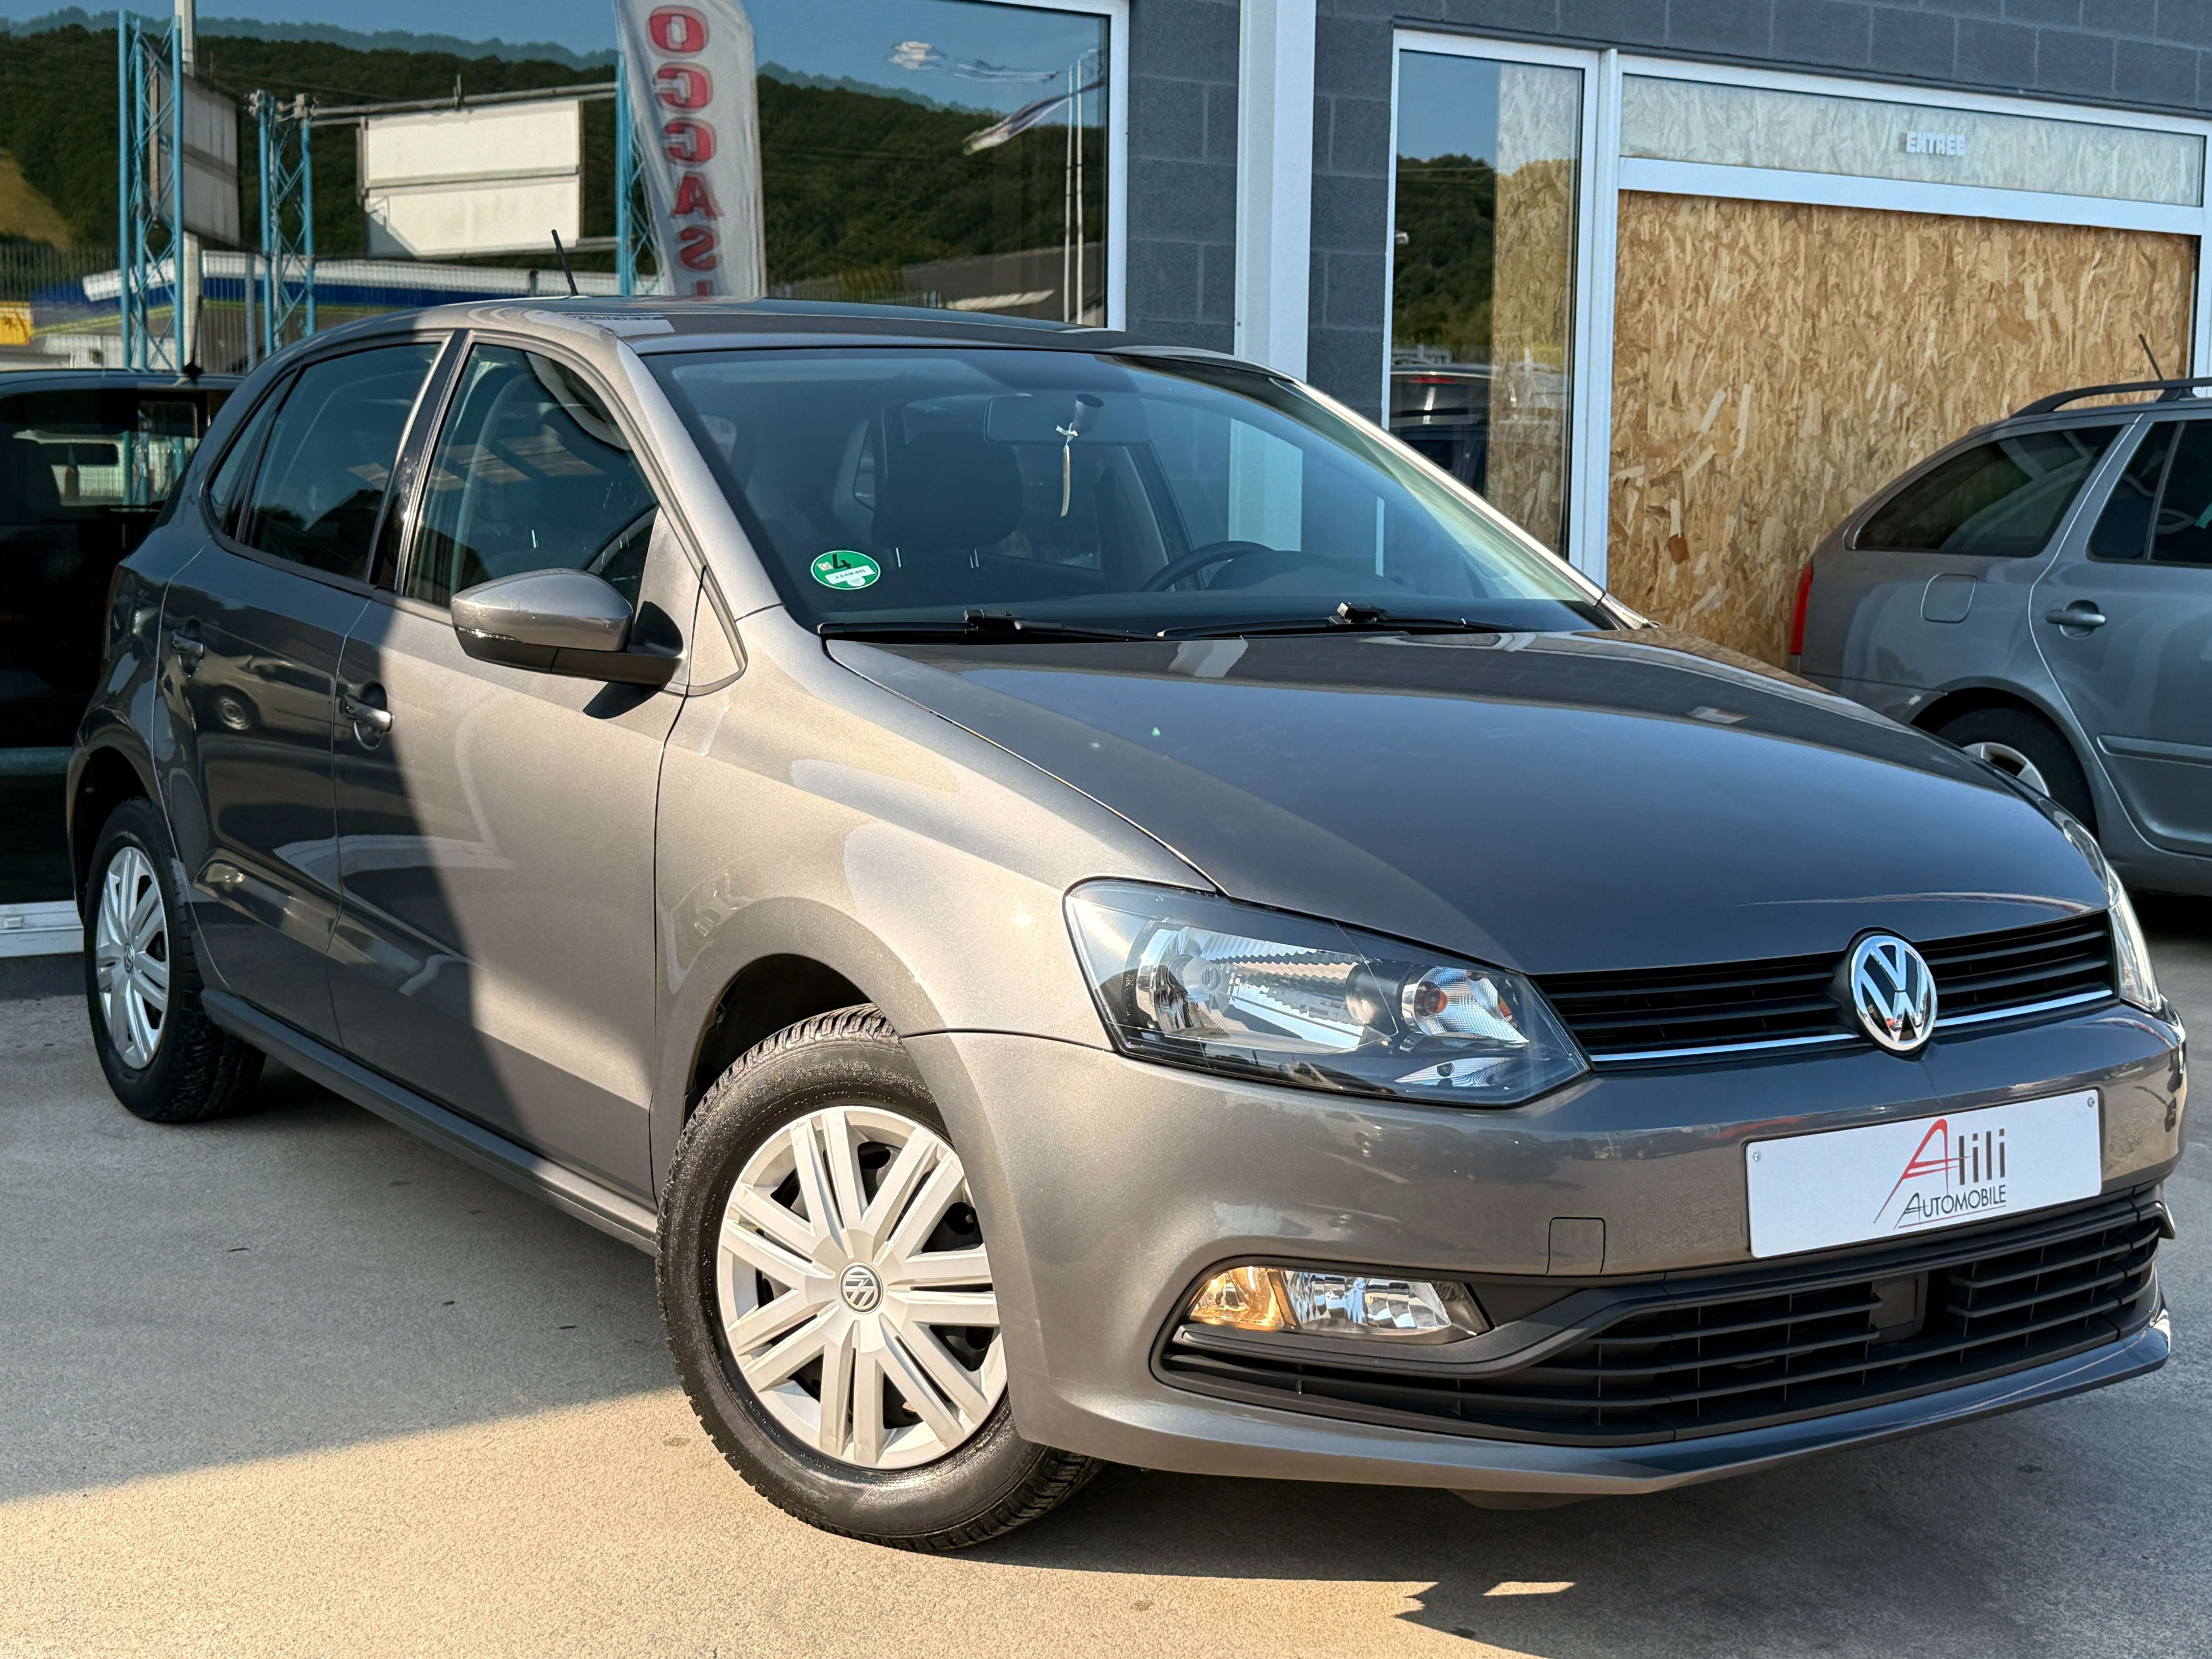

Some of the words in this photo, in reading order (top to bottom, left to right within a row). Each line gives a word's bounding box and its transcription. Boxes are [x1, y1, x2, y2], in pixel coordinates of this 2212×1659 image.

[832, 553, 851, 569] 4
[1851, 935, 1937, 1051] VW
[1874, 1118, 2006, 1224] Alili
